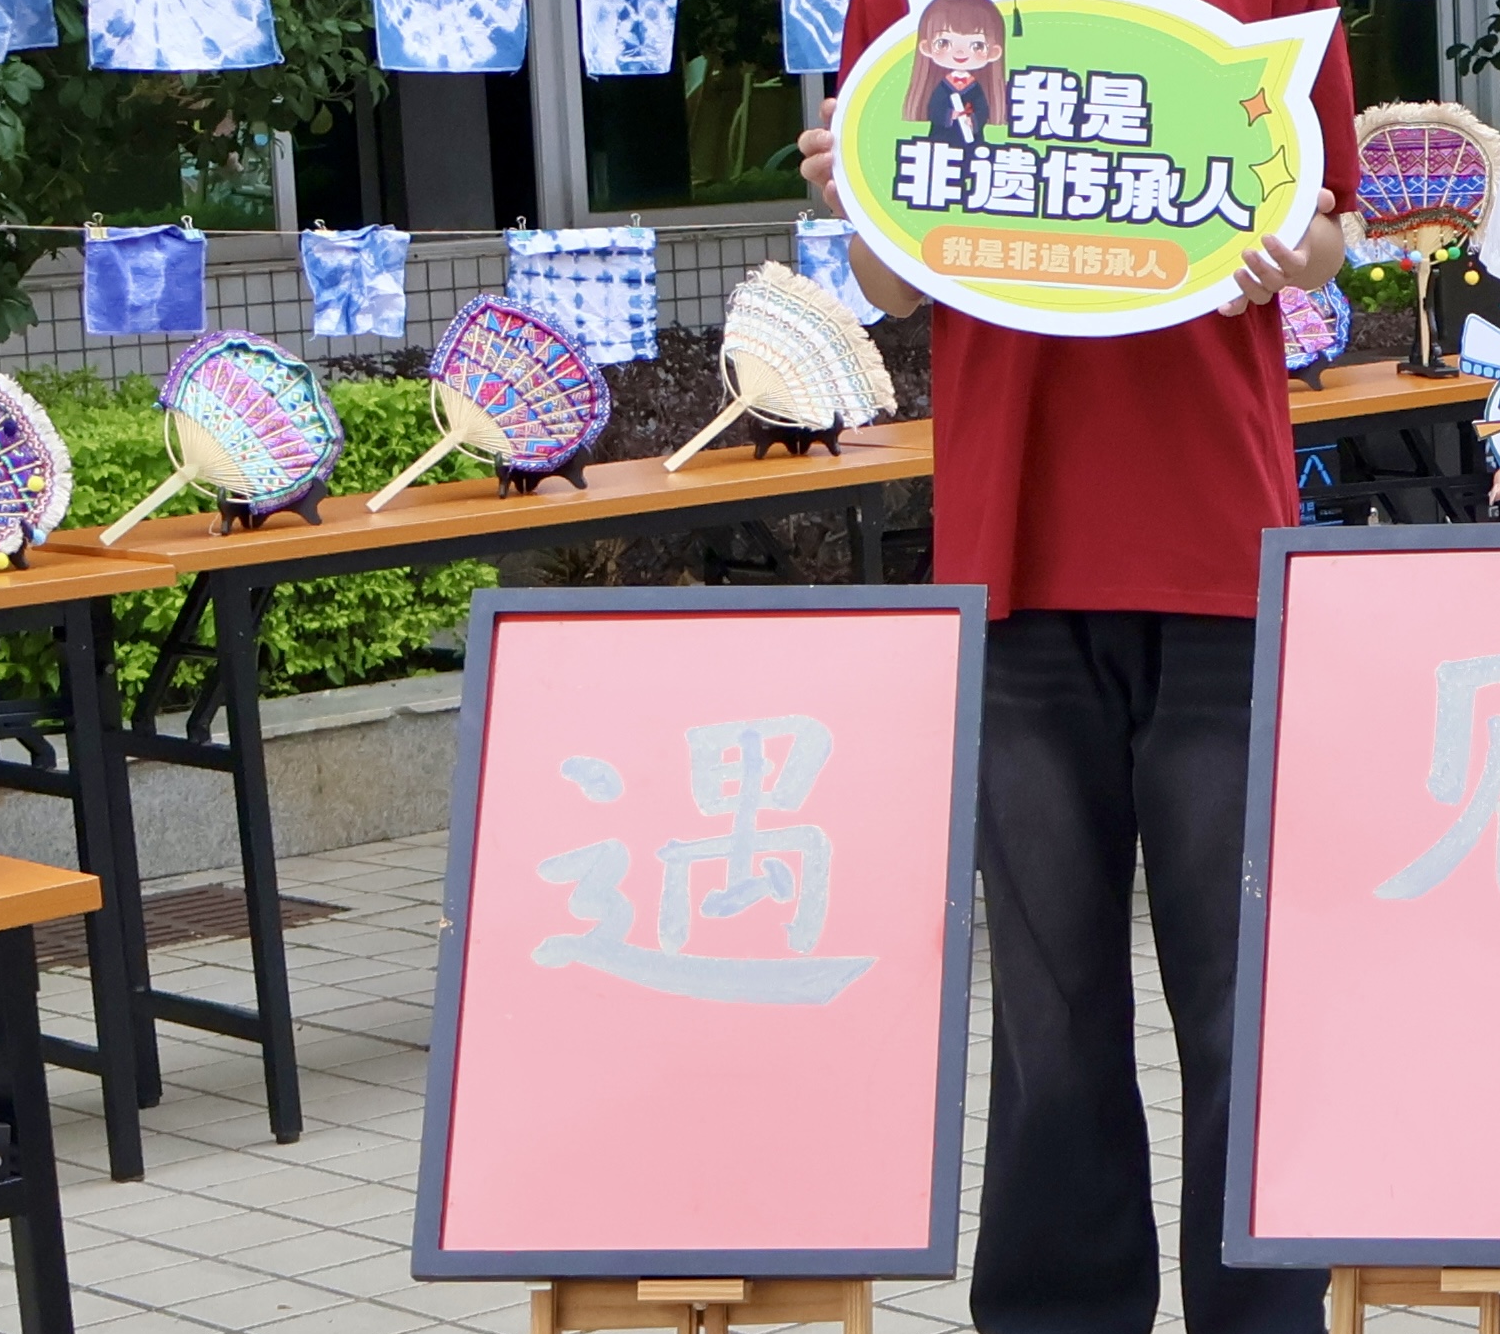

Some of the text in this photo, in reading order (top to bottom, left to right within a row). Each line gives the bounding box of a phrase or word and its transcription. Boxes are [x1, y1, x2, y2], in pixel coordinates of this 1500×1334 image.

[1009, 67, 1152, 144] 我是
[895, 141, 1255, 230] 非遗传承人
[942, 235, 1168, 280] 我是非遗传承人
[532, 715, 878, 1005] 遇
